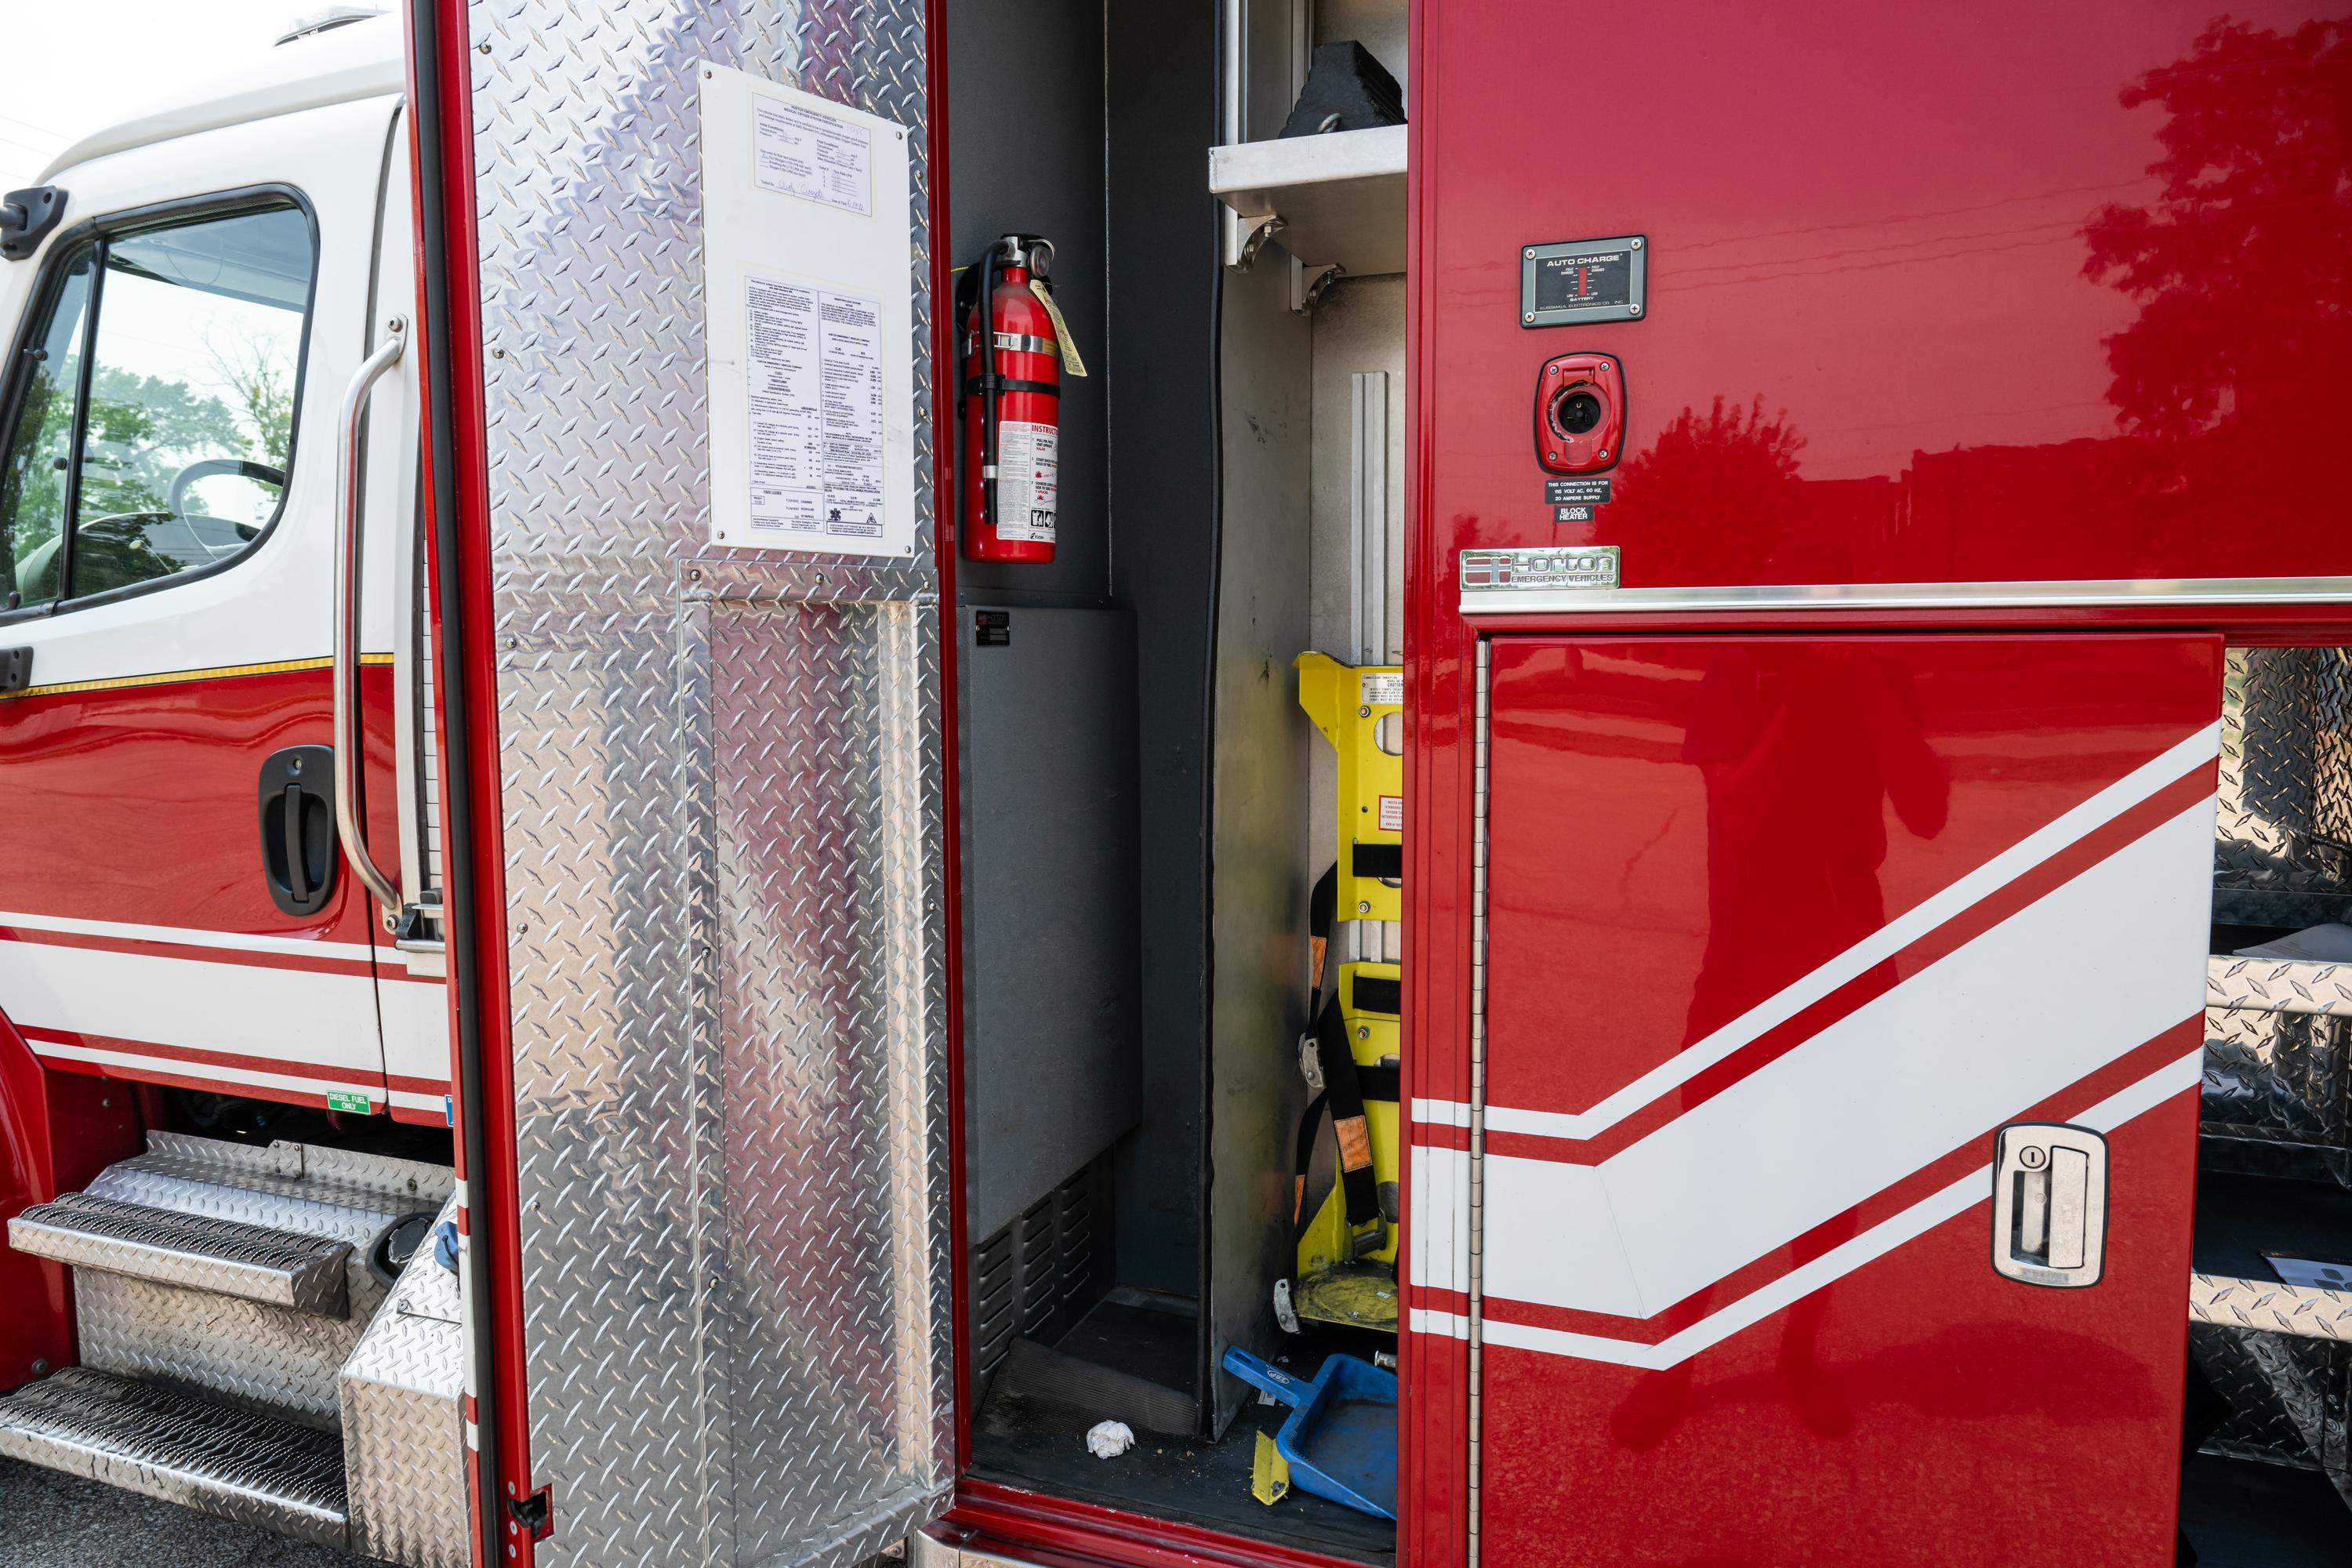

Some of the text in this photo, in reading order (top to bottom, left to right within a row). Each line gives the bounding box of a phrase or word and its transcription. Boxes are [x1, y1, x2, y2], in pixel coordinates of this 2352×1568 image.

[1547, 259, 1575, 267] AUTO
[1512, 556, 1614, 573] Horton
[1511, 574, 1613, 583] EMERGENCY VEHICLES
[329, 1093, 366, 1104] DIESEL FUEL
[341, 1102, 356, 1110] ONLY
